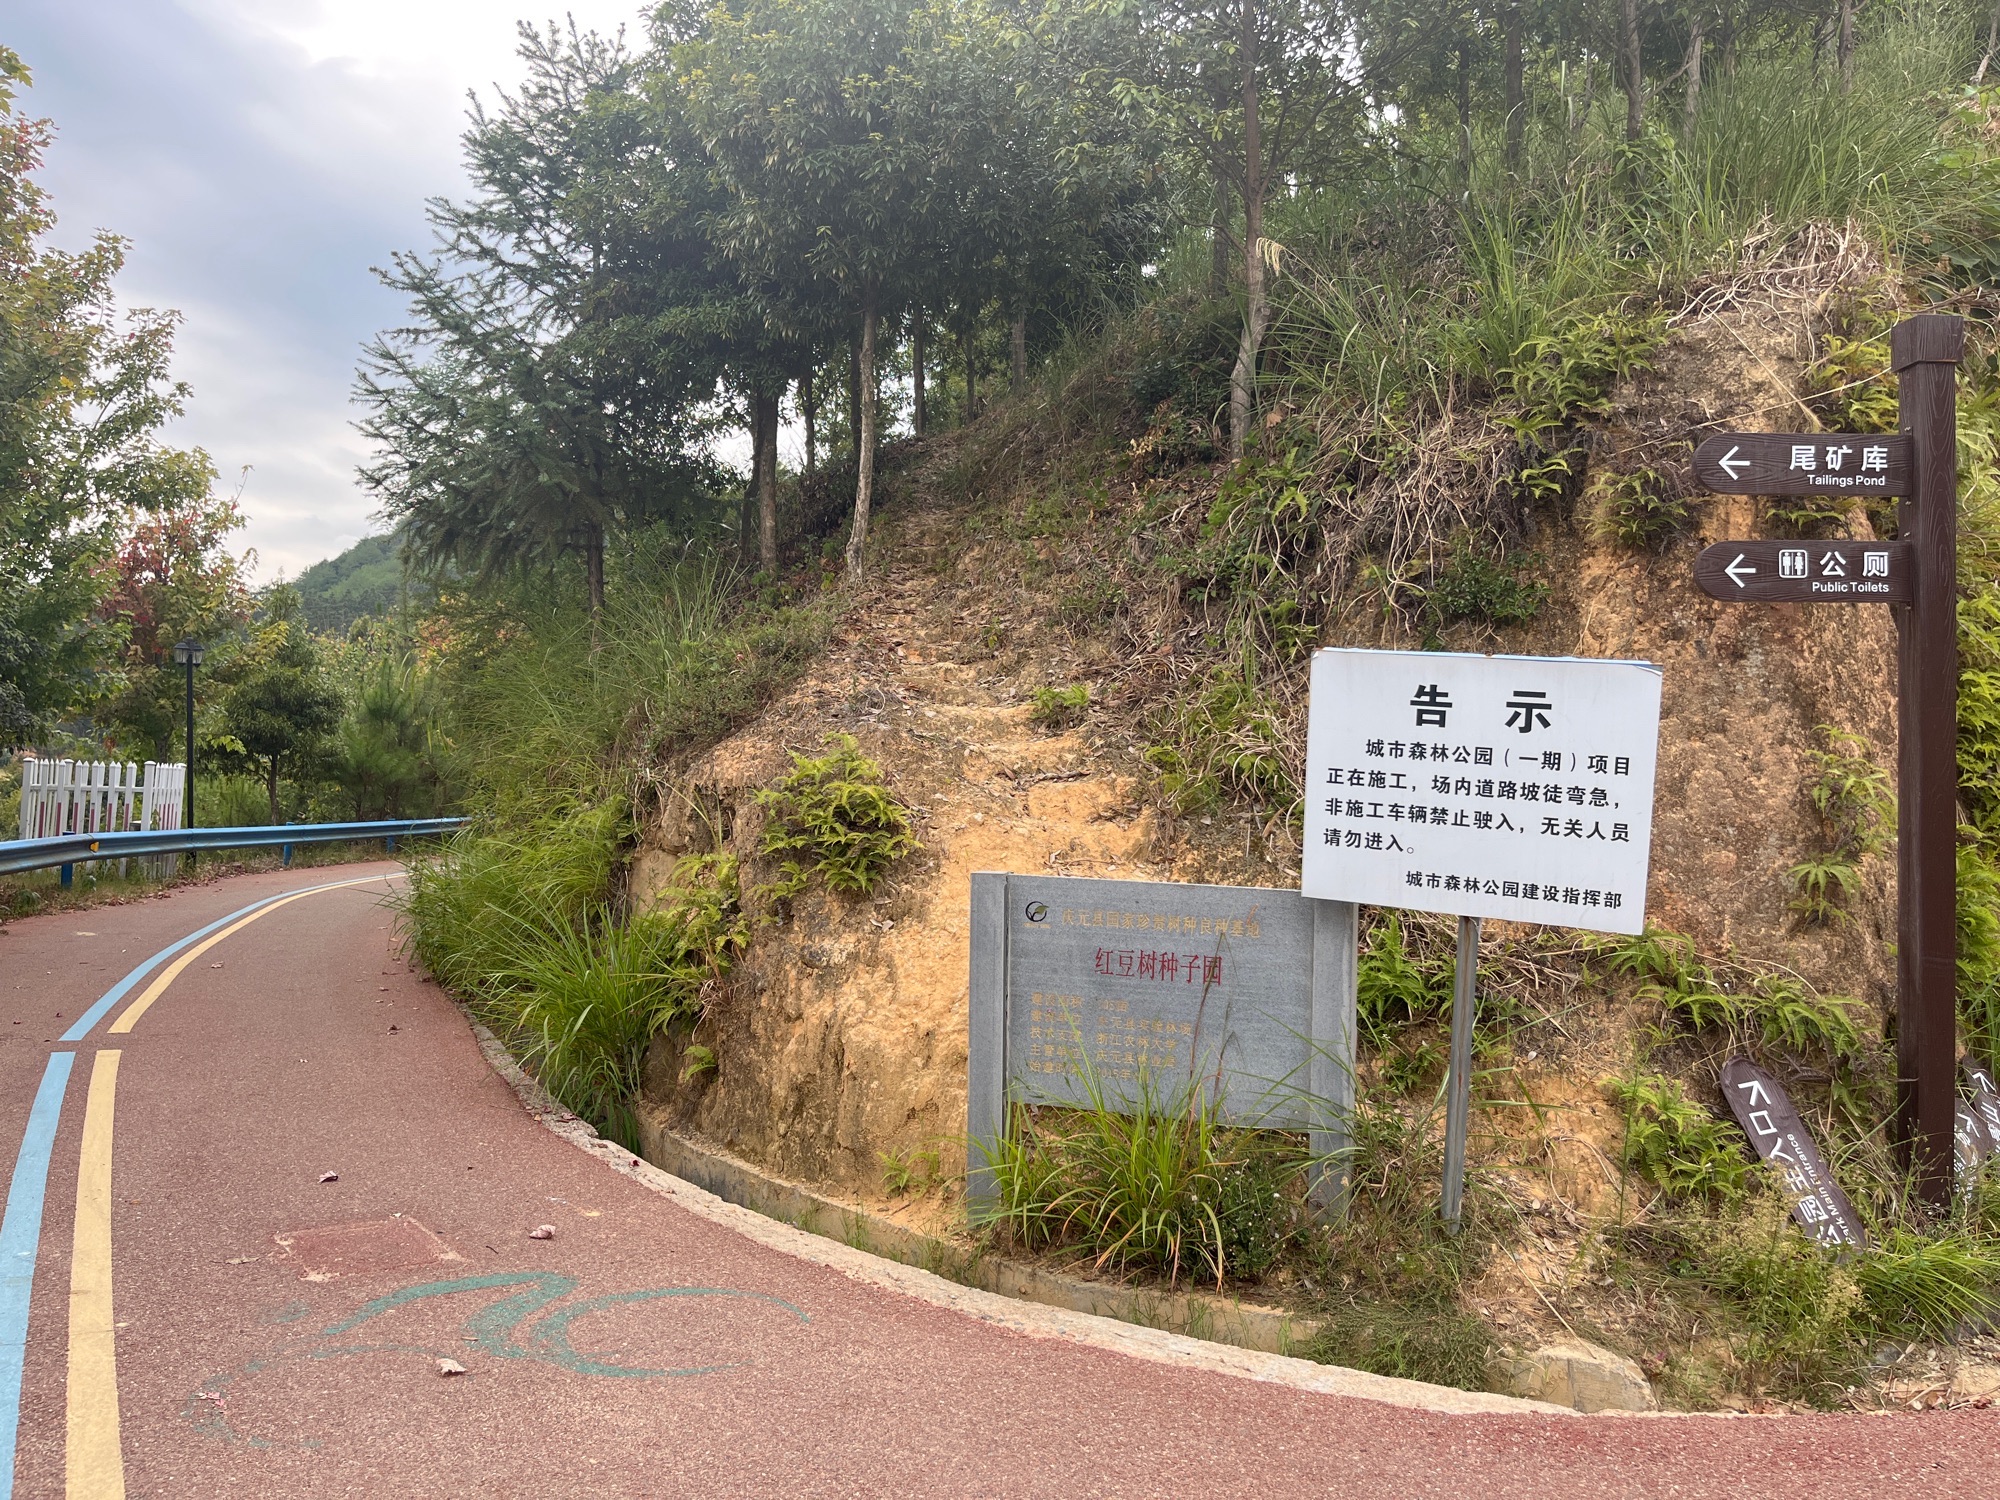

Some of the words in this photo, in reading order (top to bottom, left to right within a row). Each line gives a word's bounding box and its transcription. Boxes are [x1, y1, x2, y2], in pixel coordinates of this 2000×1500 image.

[1789, 445, 1889, 472] 尾矿库
[1807, 474, 1853, 487] Tailings
[1855, 475, 1886, 486] Pond
[1819, 551, 1889, 577] 公厕
[1812, 582, 1848, 592] Public
[1850, 582, 1890, 592] Toilets
[1323, 828, 1415, 855] 请勿进入。
[1405, 871, 1623, 910] 城市森林公园建设指挥部
[1094, 946, 1223, 985] 红豆树种子园
[1786, 1133, 1820, 1185] Entrance
[1818, 1186, 1840, 1216] Main
